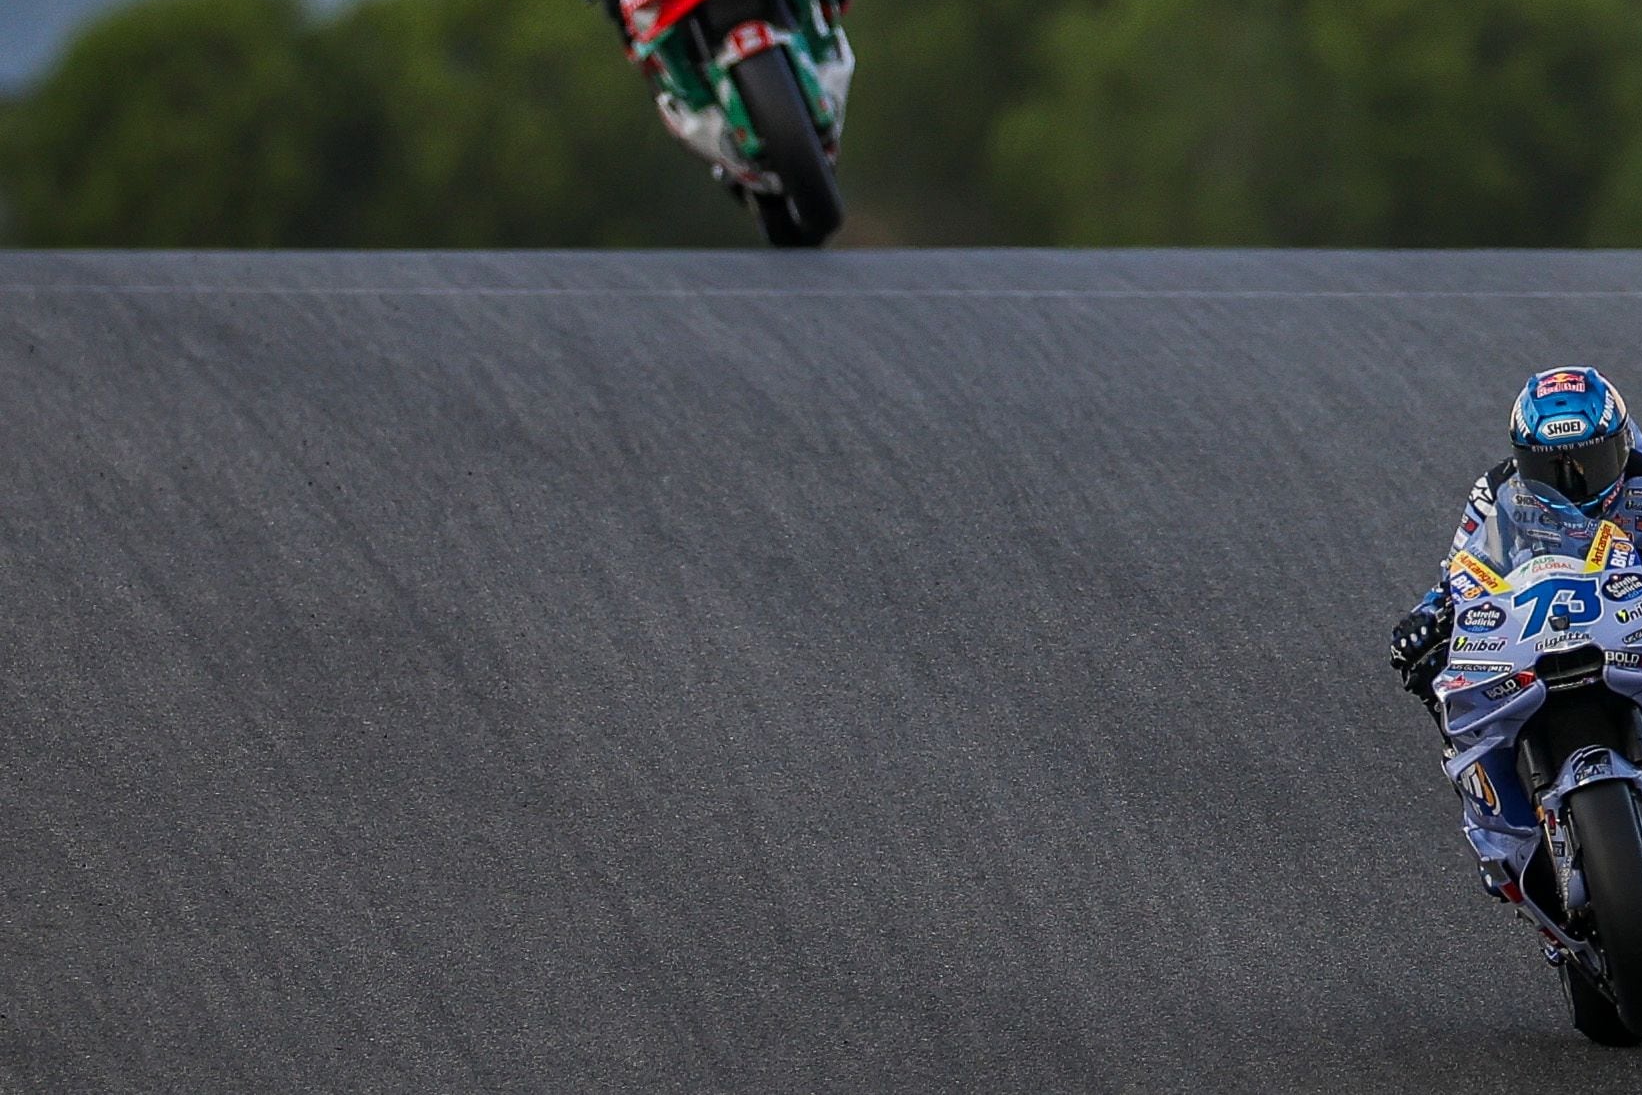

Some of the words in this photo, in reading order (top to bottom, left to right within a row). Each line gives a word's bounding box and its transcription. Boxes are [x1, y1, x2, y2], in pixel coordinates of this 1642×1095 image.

[1547, 421, 1581, 436] SHOEI
[1591, 524, 1613, 566] Antangin
[1610, 542, 1635, 568] BK8
[1460, 553, 1499, 589] Antangin
[1532, 562, 1576, 574] GLOBAL
[1450, 574, 1484, 601] BK8
[1606, 575, 1639, 593] Estrella
[1466, 609, 1501, 619] Estrella
[1511, 576, 1604, 645] 73
[1464, 617, 1497, 627] Galicia
[1452, 636, 1507, 652] Unibat
[1605, 651, 1640, 664] BOLD
[1486, 679, 1517, 698] BOLD
